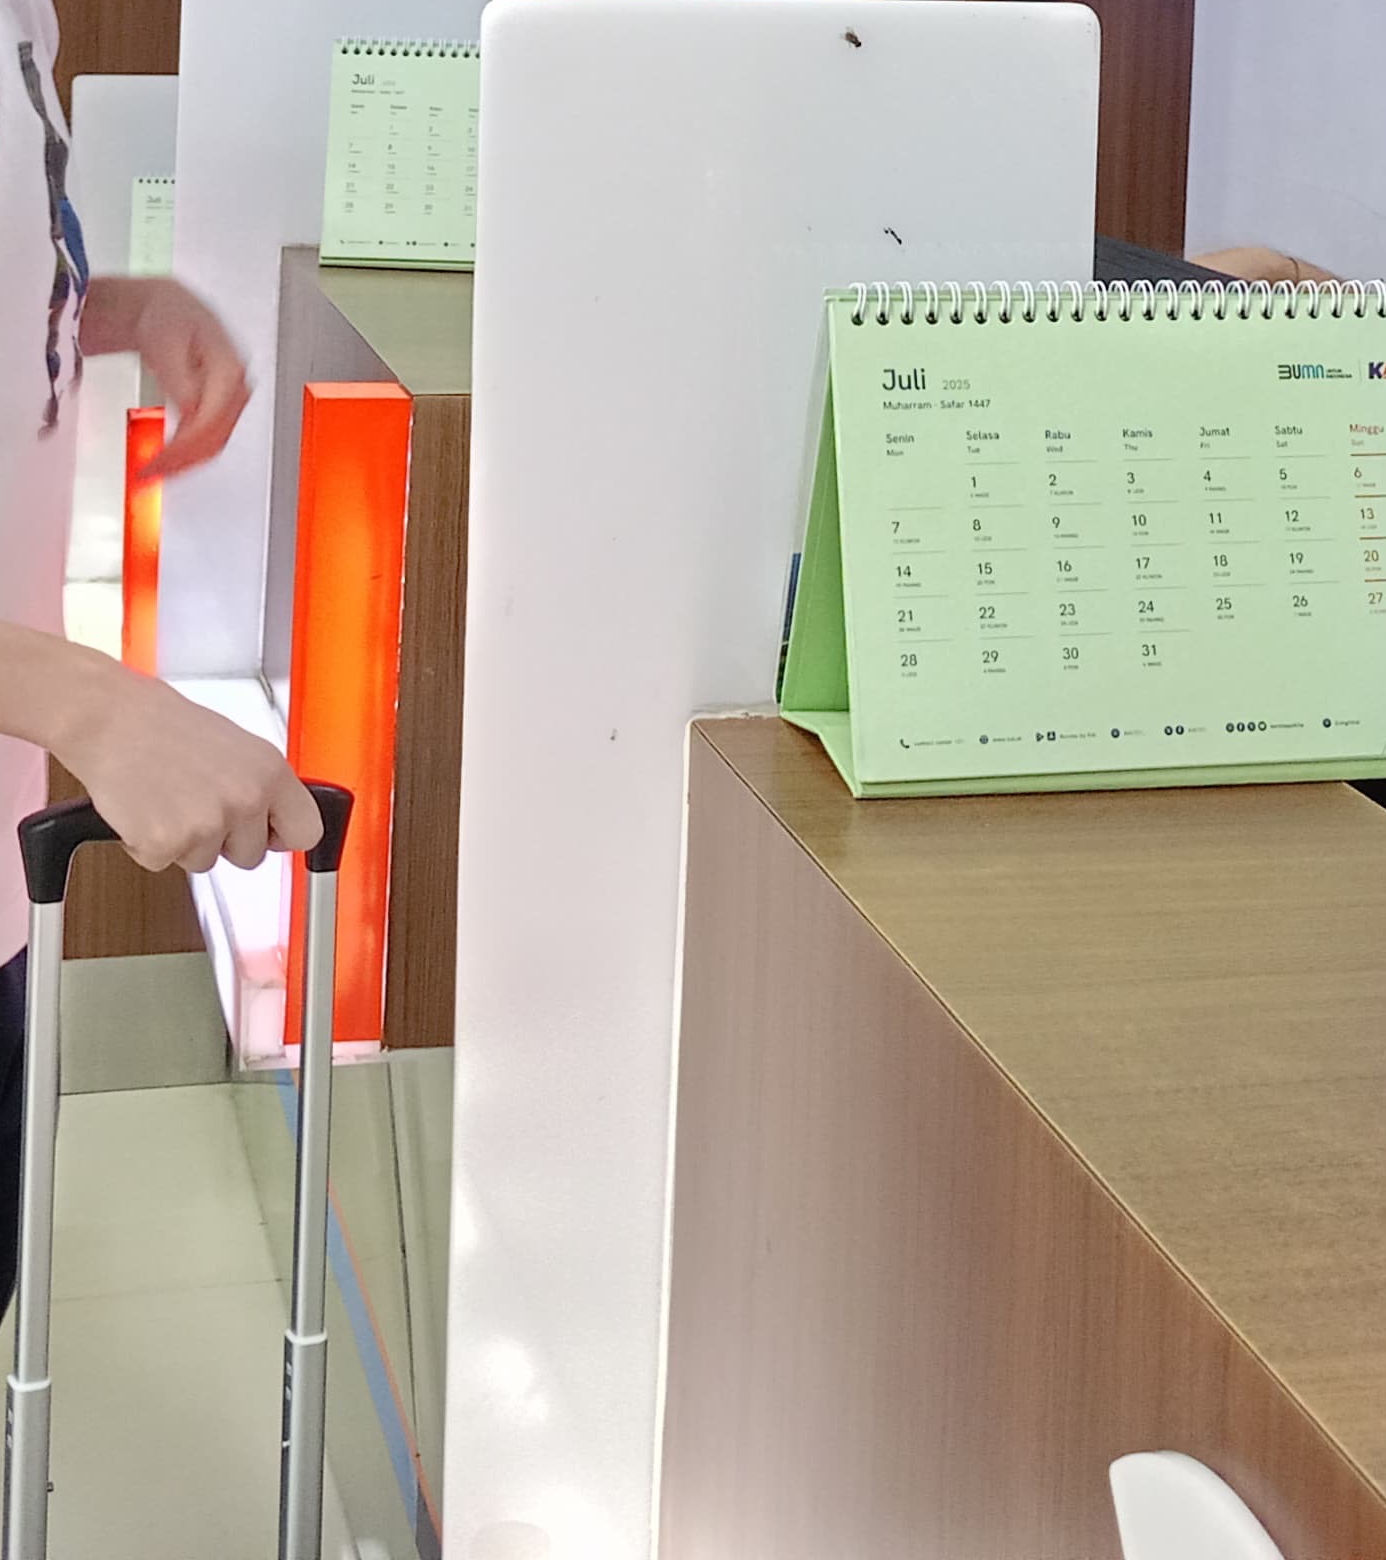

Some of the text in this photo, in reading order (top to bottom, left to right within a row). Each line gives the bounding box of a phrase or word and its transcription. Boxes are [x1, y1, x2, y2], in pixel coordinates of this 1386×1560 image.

[882, 368, 971, 391] Juli 2025
[882, 400, 932, 411] Muharram
[940, 398, 965, 410] Safar
[968, 399, 991, 409] 1447
[966, 429, 1000, 441] Selasa
[1044, 429, 1071, 440] Rabu
[1122, 428, 1153, 439] Kamis
[1199, 426, 1230, 438] Jumat
[1274, 424, 1303, 436] Sabtu
[1349, 423, 1385, 435] Minggu
[886, 433, 915, 444] Senin
[1126, 472, 1136, 484] 3
[1203, 470, 1212, 482] 4
[1279, 468, 1288, 481] 5
[1354, 466, 1362, 479] 6
[970, 476, 977, 488] 1
[1048, 474, 1058, 486] 2
[1132, 514, 1147, 527] 10
[1209, 512, 1223, 524] 11
[1285, 510, 1300, 522] 12
[1360, 508, 1375, 521] 13
[892, 521, 900, 533] 7
[973, 519, 981, 531] 8
[1052, 516, 1061, 528] 9
[1213, 555, 1228, 567] 18
[1289, 552, 1304, 565] 19
[1364, 550, 1379, 563] 20
[977, 562, 993, 575] 15
[1057, 560, 1073, 572] 16
[1135, 557, 1150, 570] 17
[896, 565, 912, 577] 14
[1215, 598, 1232, 611] 25
[1292, 595, 1308, 608] 26
[1368, 592, 1384, 605] 27
[979, 606, 996, 619] 22
[1059, 603, 1076, 616] 23
[1138, 601, 1155, 613] 24
[897, 610, 914, 623] 21
[1062, 647, 1079, 660] 30
[1141, 644, 1157, 657] 31
[900, 654, 918, 667] 28
[982, 651, 1000, 663] 29
